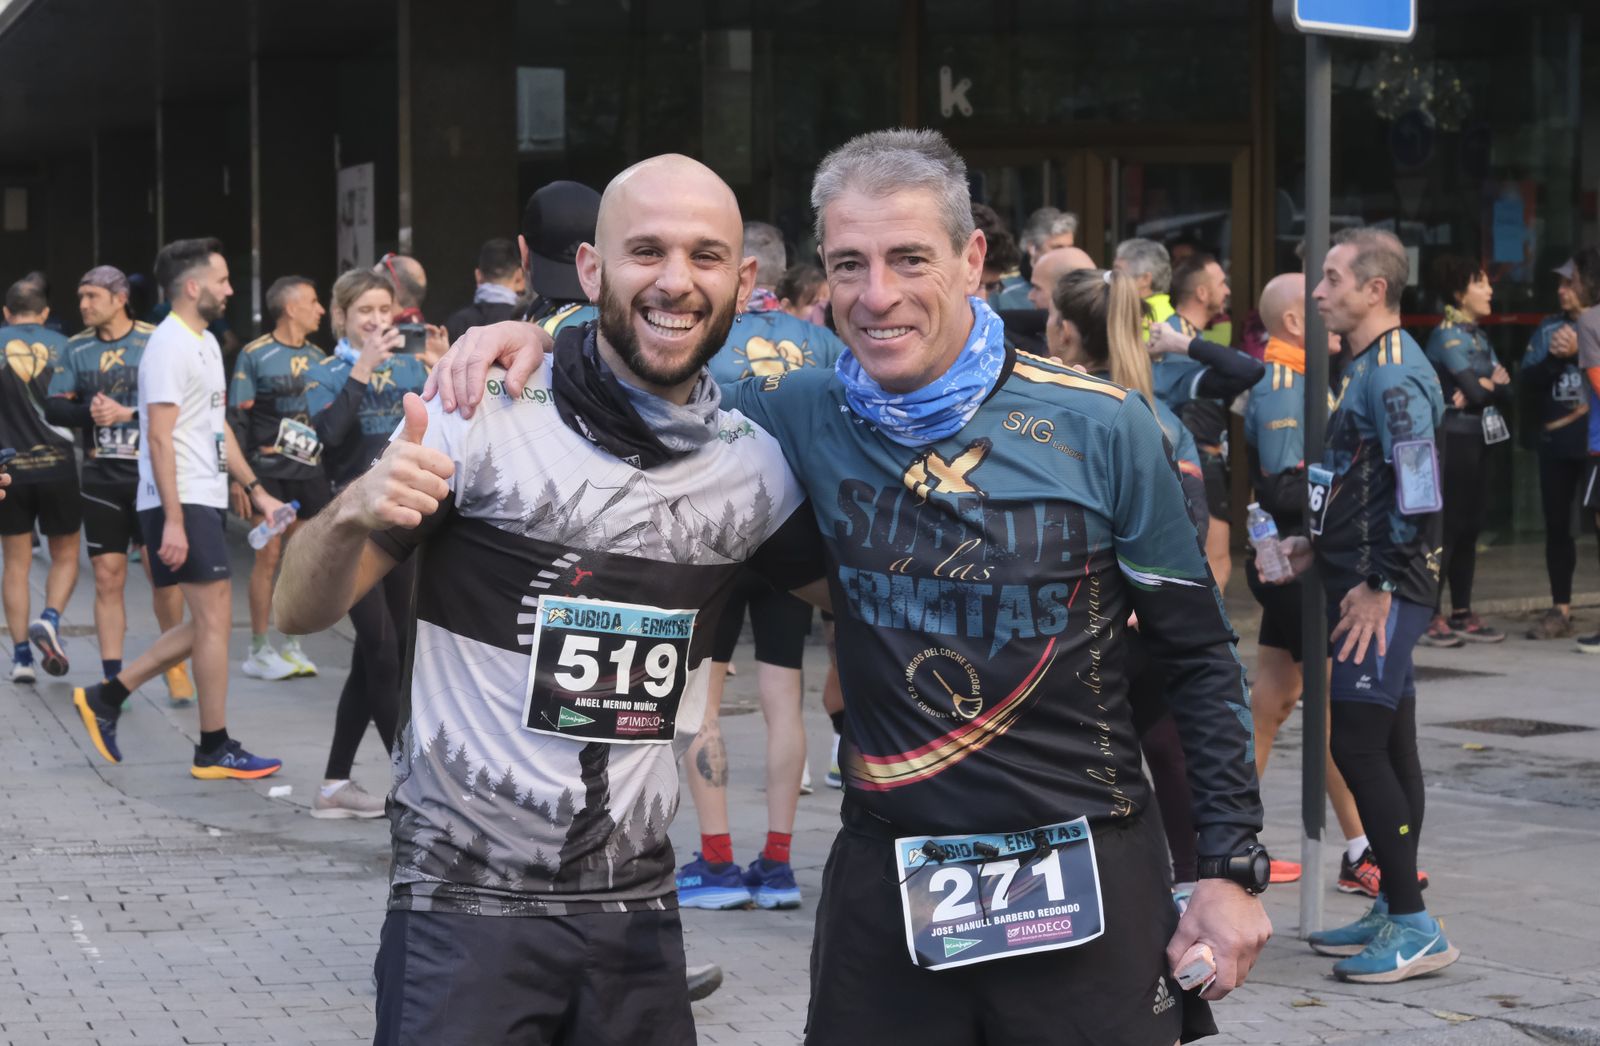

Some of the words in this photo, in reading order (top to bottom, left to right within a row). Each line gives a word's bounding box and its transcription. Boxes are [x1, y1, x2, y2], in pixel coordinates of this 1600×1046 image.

[98, 427, 140, 444] 317
[1003, 409, 1056, 444] SIG
[889, 553, 915, 573] a
[933, 537, 995, 581] las
[563, 607, 623, 631] SUBIDA
[553, 634, 678, 698] 519
[905, 652, 925, 683] AMIGOS
[924, 647, 939, 658] DEL
[940, 647, 967, 666] COCHE
[963, 663, 981, 695] ESCOBA
[574, 697, 601, 708] ANGEL
[602, 699, 632, 710] MERINO
[633, 700, 658, 712] MUÑOZ
[1005, 826, 1082, 851] ERMTAS
[928, 848, 1066, 923] 271
[931, 925, 954, 937] JOSE
[993, 909, 1036, 926] BARBERO
[1037, 903, 1080, 919] REDONDO
[1021, 919, 1071, 936] IMDECO
[1152, 995, 1176, 1015] adidas
